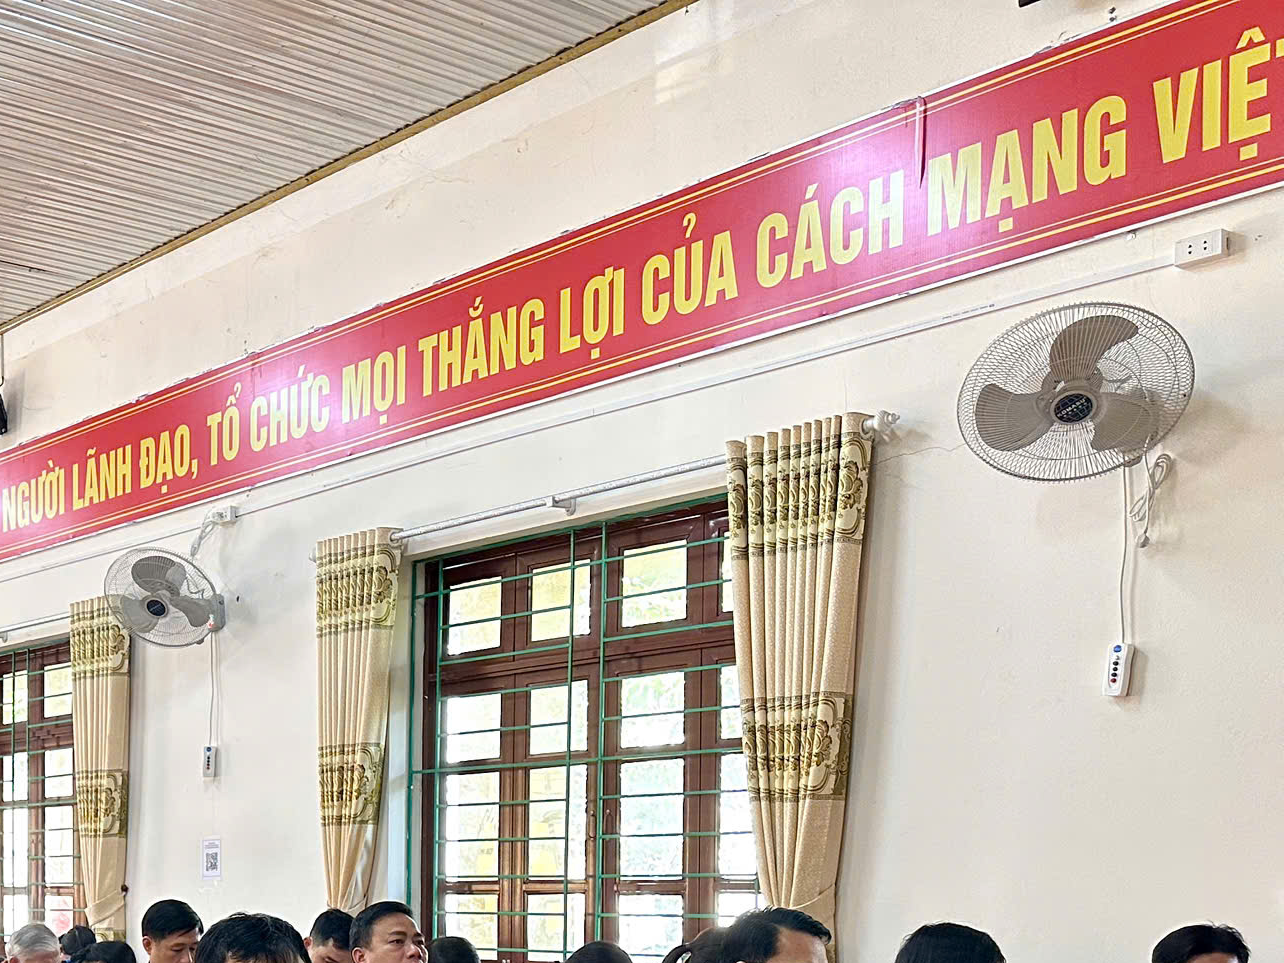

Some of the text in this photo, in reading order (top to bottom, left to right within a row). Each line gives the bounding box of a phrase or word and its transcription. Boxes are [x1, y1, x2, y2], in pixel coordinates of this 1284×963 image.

[2, 460, 65, 533] NGƯỜI
[72, 447, 132, 511] LÃNH
[139, 423, 198, 494] ĐẠO,
[207, 382, 240, 464] TỔ
[249, 364, 330, 451] CHỨC
[342, 345, 406, 424] MỌI
[419, 296, 544, 396] THẮNG
[559, 267, 625, 356] LỢI
[641, 213, 738, 325] CỦA
[756, 169, 905, 288] CÁCH
[927, 95, 1127, 233] MẠNG
[1153, 26, 1284, 163] VIỆ
